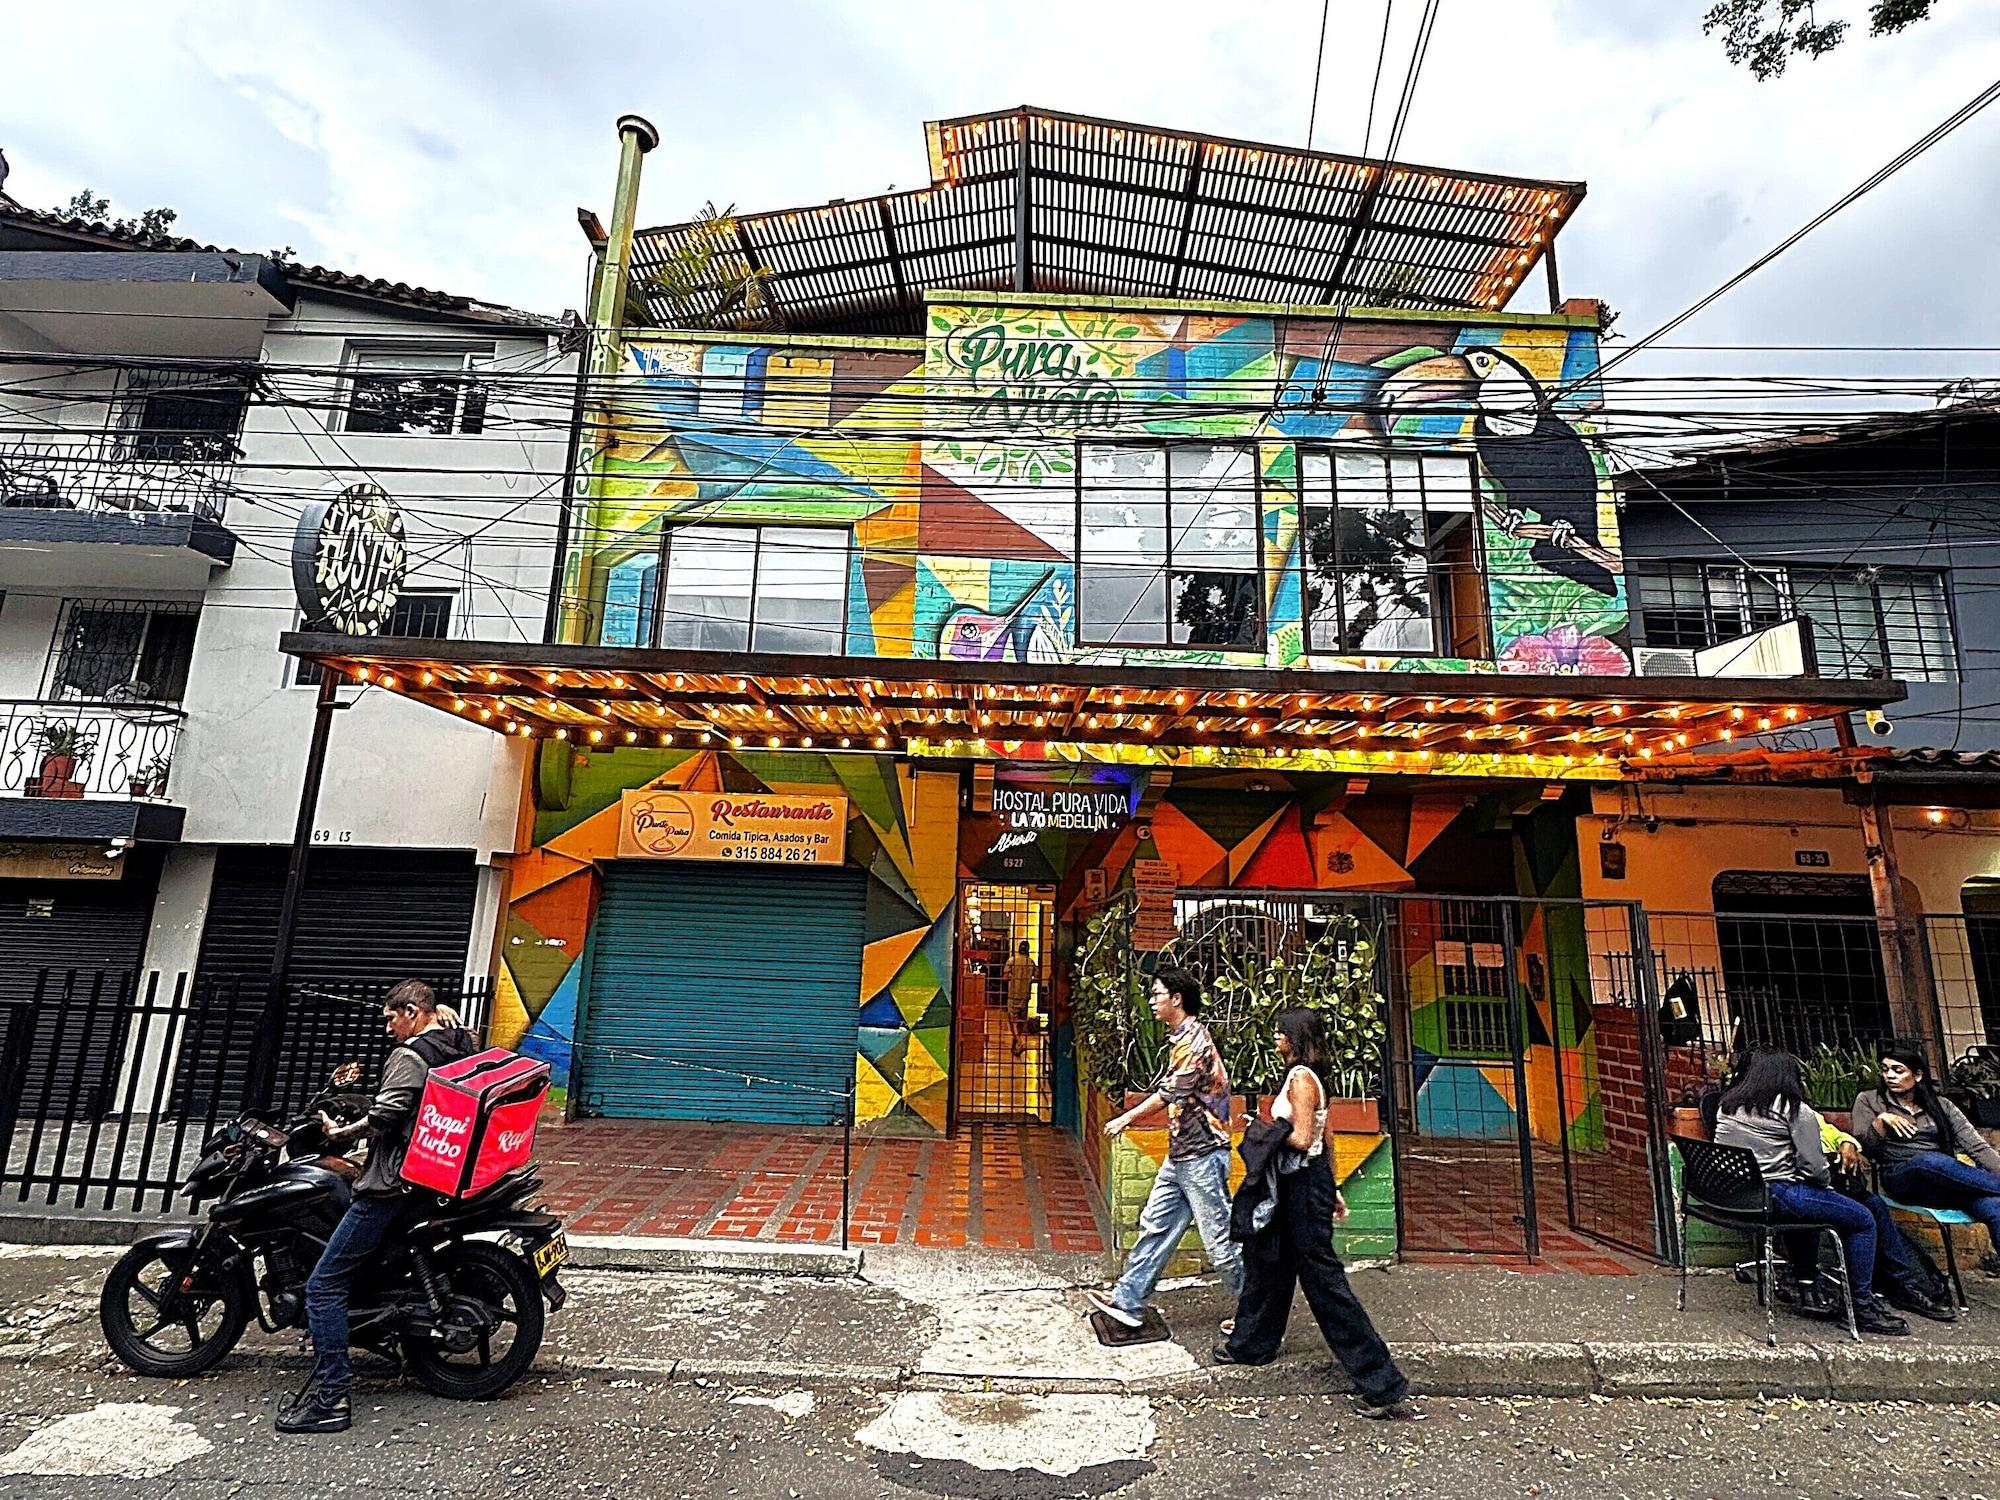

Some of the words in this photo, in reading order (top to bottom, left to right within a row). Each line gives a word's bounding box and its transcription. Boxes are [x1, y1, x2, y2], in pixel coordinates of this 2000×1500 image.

[946, 324, 1081, 391] Pura
[711, 799, 834, 827] Restaurante
[993, 789, 1050, 811] HOSTAL
[1052, 791, 1091, 813] PURA
[1094, 793, 1129, 814] VIDA
[1011, 811, 1029, 828] LA
[1029, 811, 1046, 828] 70
[314, 830, 330, 842] 69
[709, 829, 741, 841] Comida
[773, 832, 805, 844] Asados
[806, 836, 812, 846] y
[814, 833, 830, 844] Bar
[735, 846, 758, 860] 315
[760, 847, 783, 861] 884
[785, 848, 801, 861] 26
[802, 848, 817, 862] 21
[422, 1103, 470, 1138] Rappi
[416, 1124, 461, 1158] Turbo
